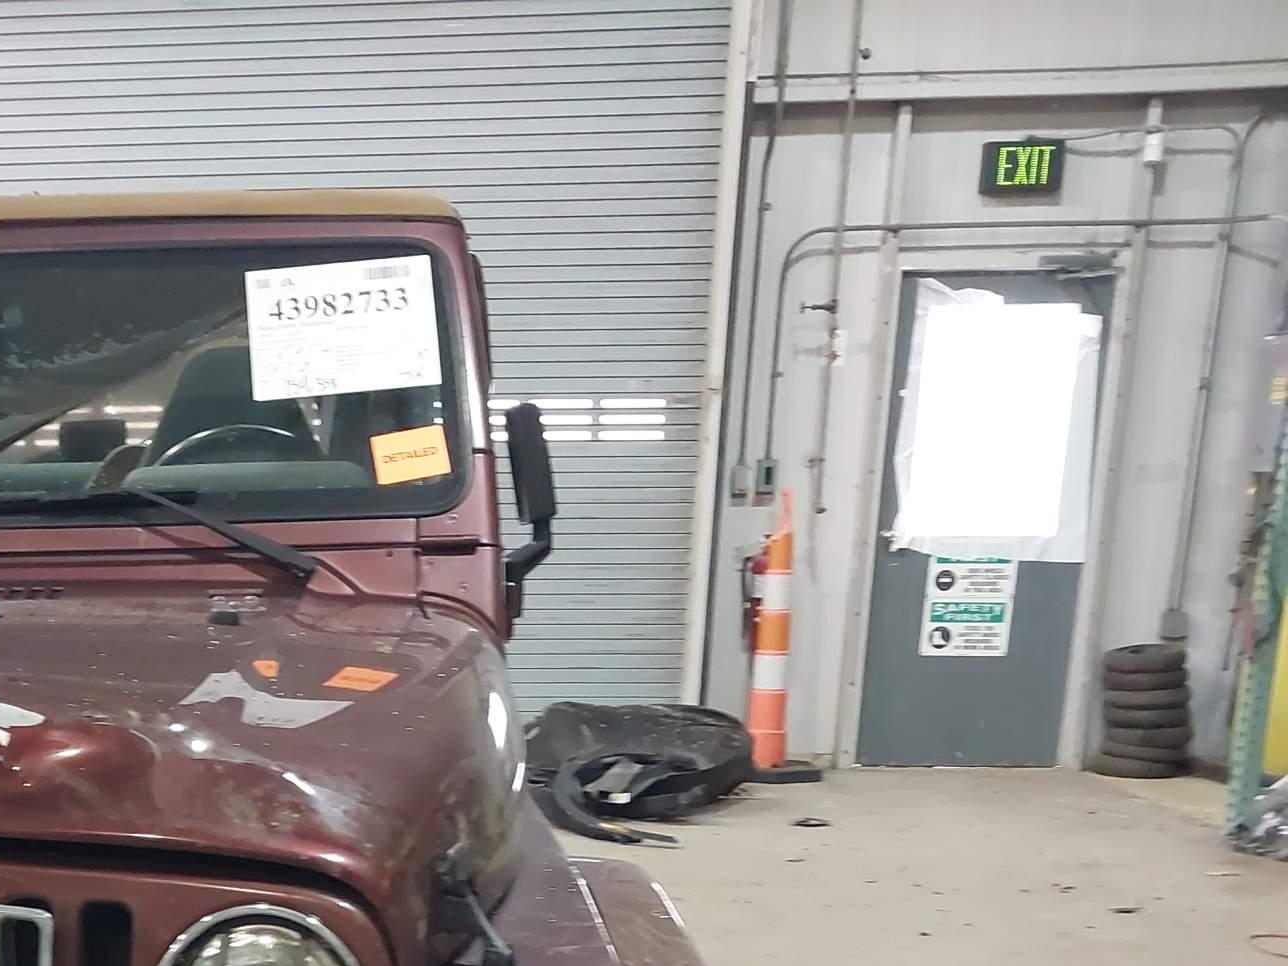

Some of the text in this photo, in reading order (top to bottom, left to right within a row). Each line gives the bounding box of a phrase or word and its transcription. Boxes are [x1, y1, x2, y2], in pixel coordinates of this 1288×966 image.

[996, 146, 1056, 185] EXIT
[268, 287, 410, 321] 43982733
[380, 446, 439, 464] DETAILED
[932, 603, 1002, 615] SAFETY
